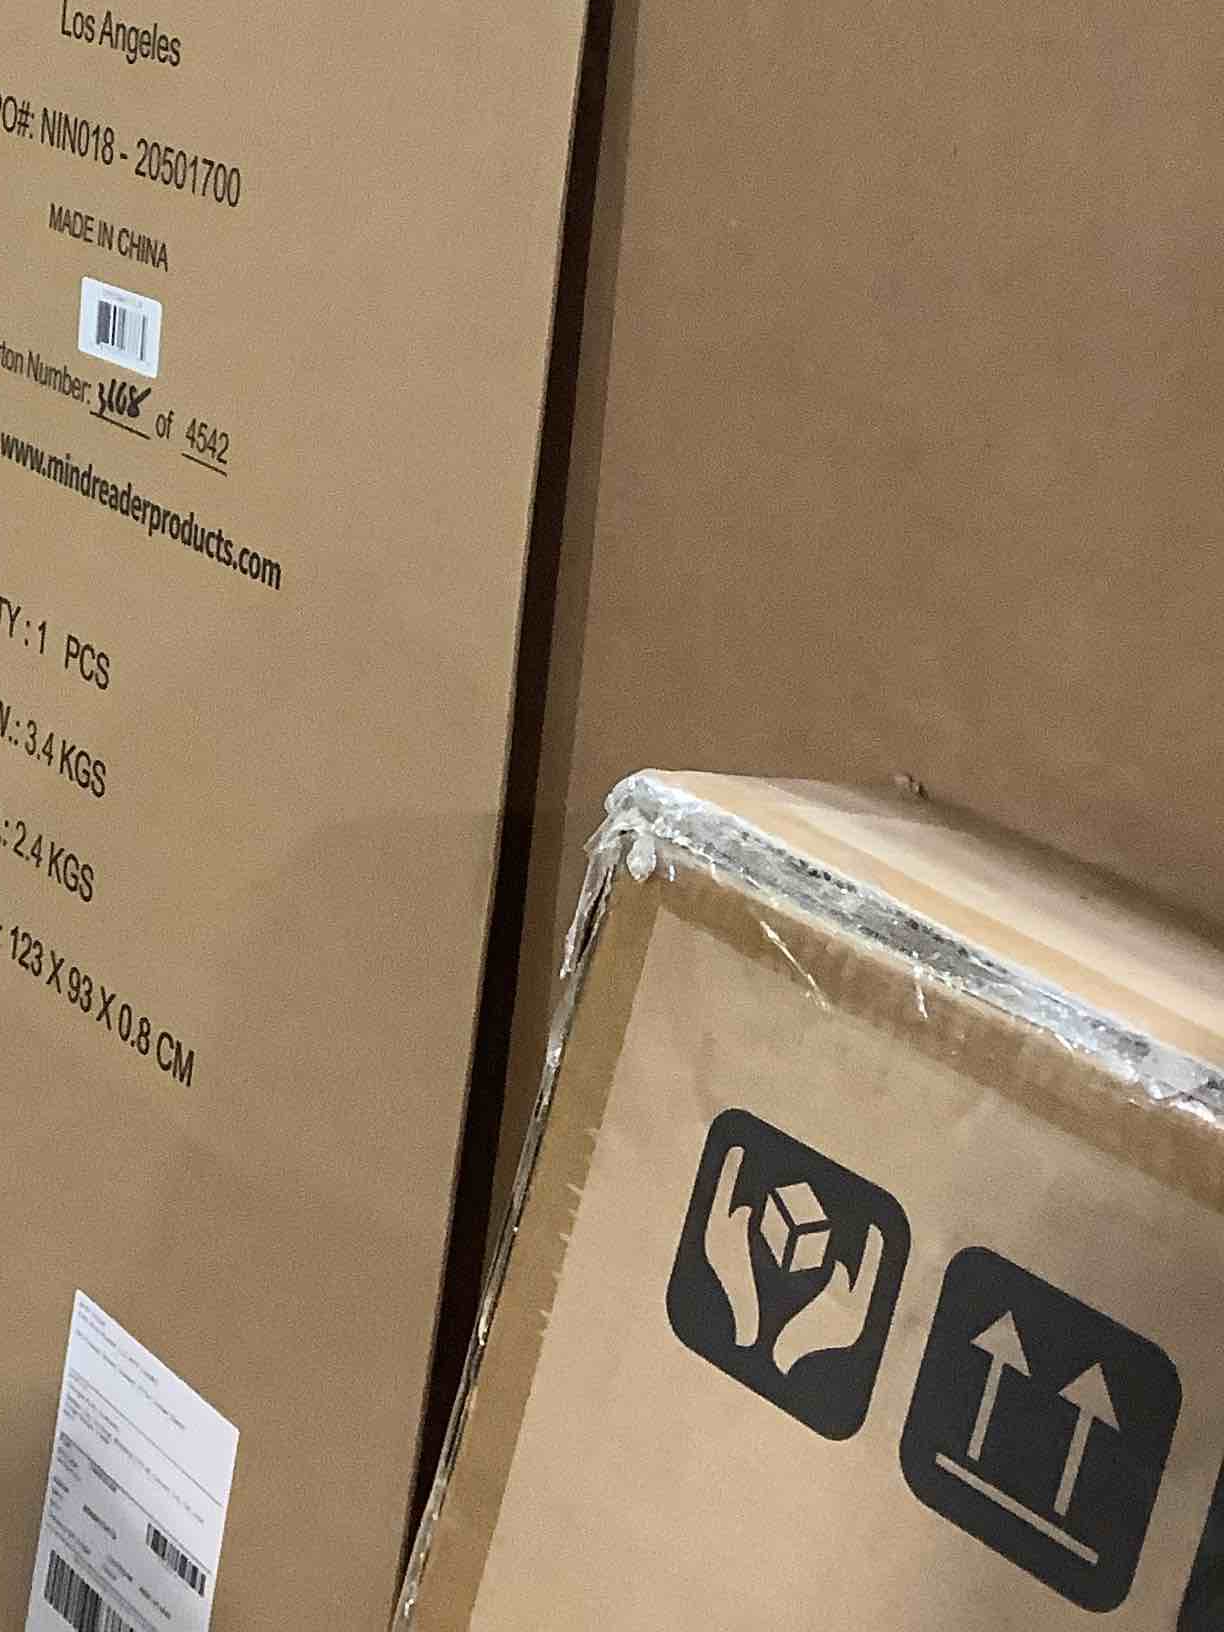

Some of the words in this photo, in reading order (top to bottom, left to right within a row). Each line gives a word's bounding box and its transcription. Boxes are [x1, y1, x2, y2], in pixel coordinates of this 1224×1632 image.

[98, 10, 181, 67] Angeles
[40, 107, 114, 166] NIN018
[134, 138, 241, 207] 20501700
[48, 203, 94, 243] MADE
[97, 221, 114, 251] IN
[117, 227, 168, 273] CHINA
[26, 351, 91, 405] Number:
[155, 410, 175, 440] of
[184, 418, 230, 465] 4542
[0, 430, 282, 591] www.mindreaderproducts.com
[64, 634, 110, 691] PCS
[24, 719, 54, 767] 3.4
[59, 739, 107, 798] KGS
[13, 820, 43, 868] 2.4
[47, 841, 94, 903] KGS
[9, 925, 43, 977] 123
[46, 949, 65, 995] X
[67, 966, 94, 1013] 93
[96, 985, 117, 1031] X
[118, 1002, 152, 1056] 0.8
[156, 1031, 195, 1088] CM
